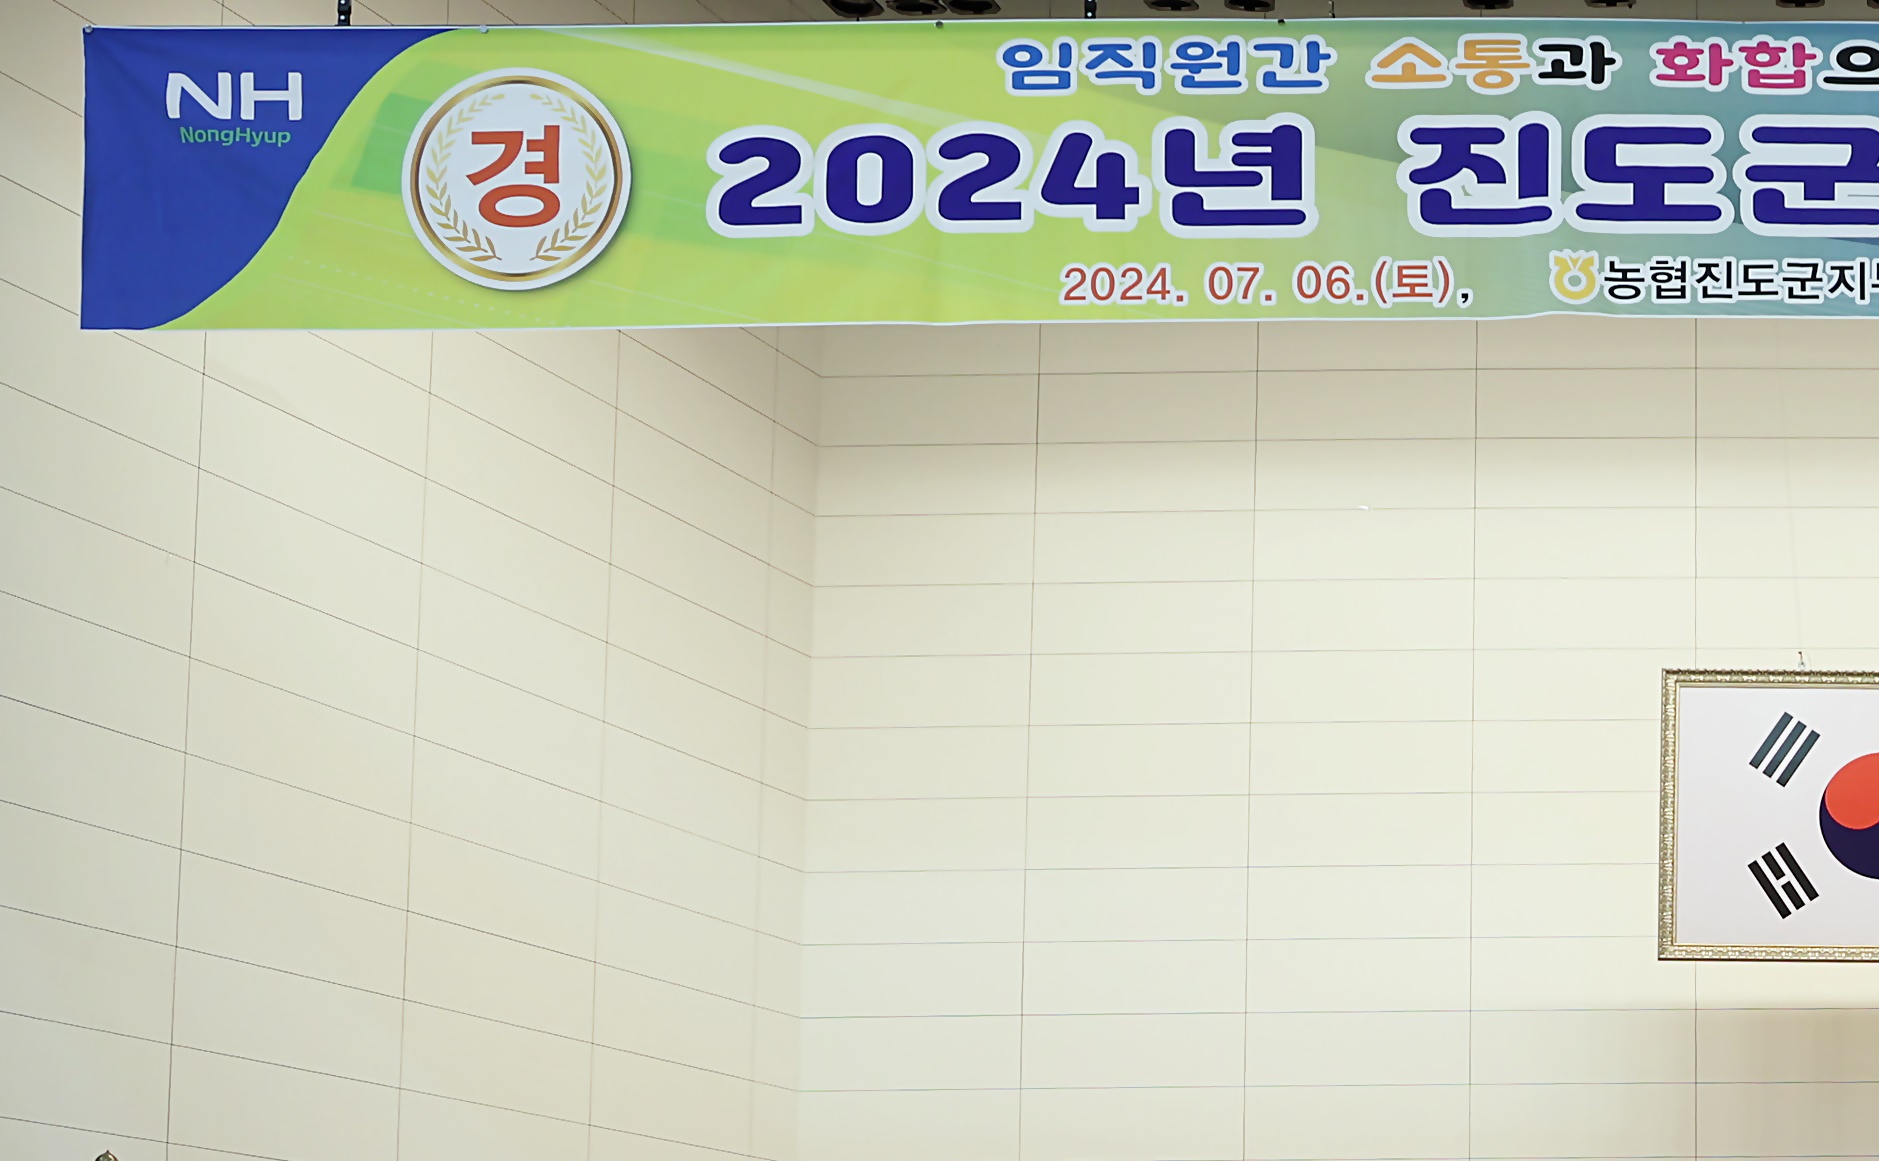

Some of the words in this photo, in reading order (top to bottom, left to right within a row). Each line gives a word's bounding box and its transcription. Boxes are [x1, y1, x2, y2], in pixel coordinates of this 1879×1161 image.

[1002, 39, 1330, 91] 임직원간
[1372, 38, 1614, 88] 소통과
[166, 72, 302, 120] NH
[180, 126, 291, 147] NongHyup
[466, 124, 561, 228] 경
[718, 125, 1304, 225] 2024년
[1063, 267, 1184, 303] 2024.
[1208, 267, 1272, 303] 07.
